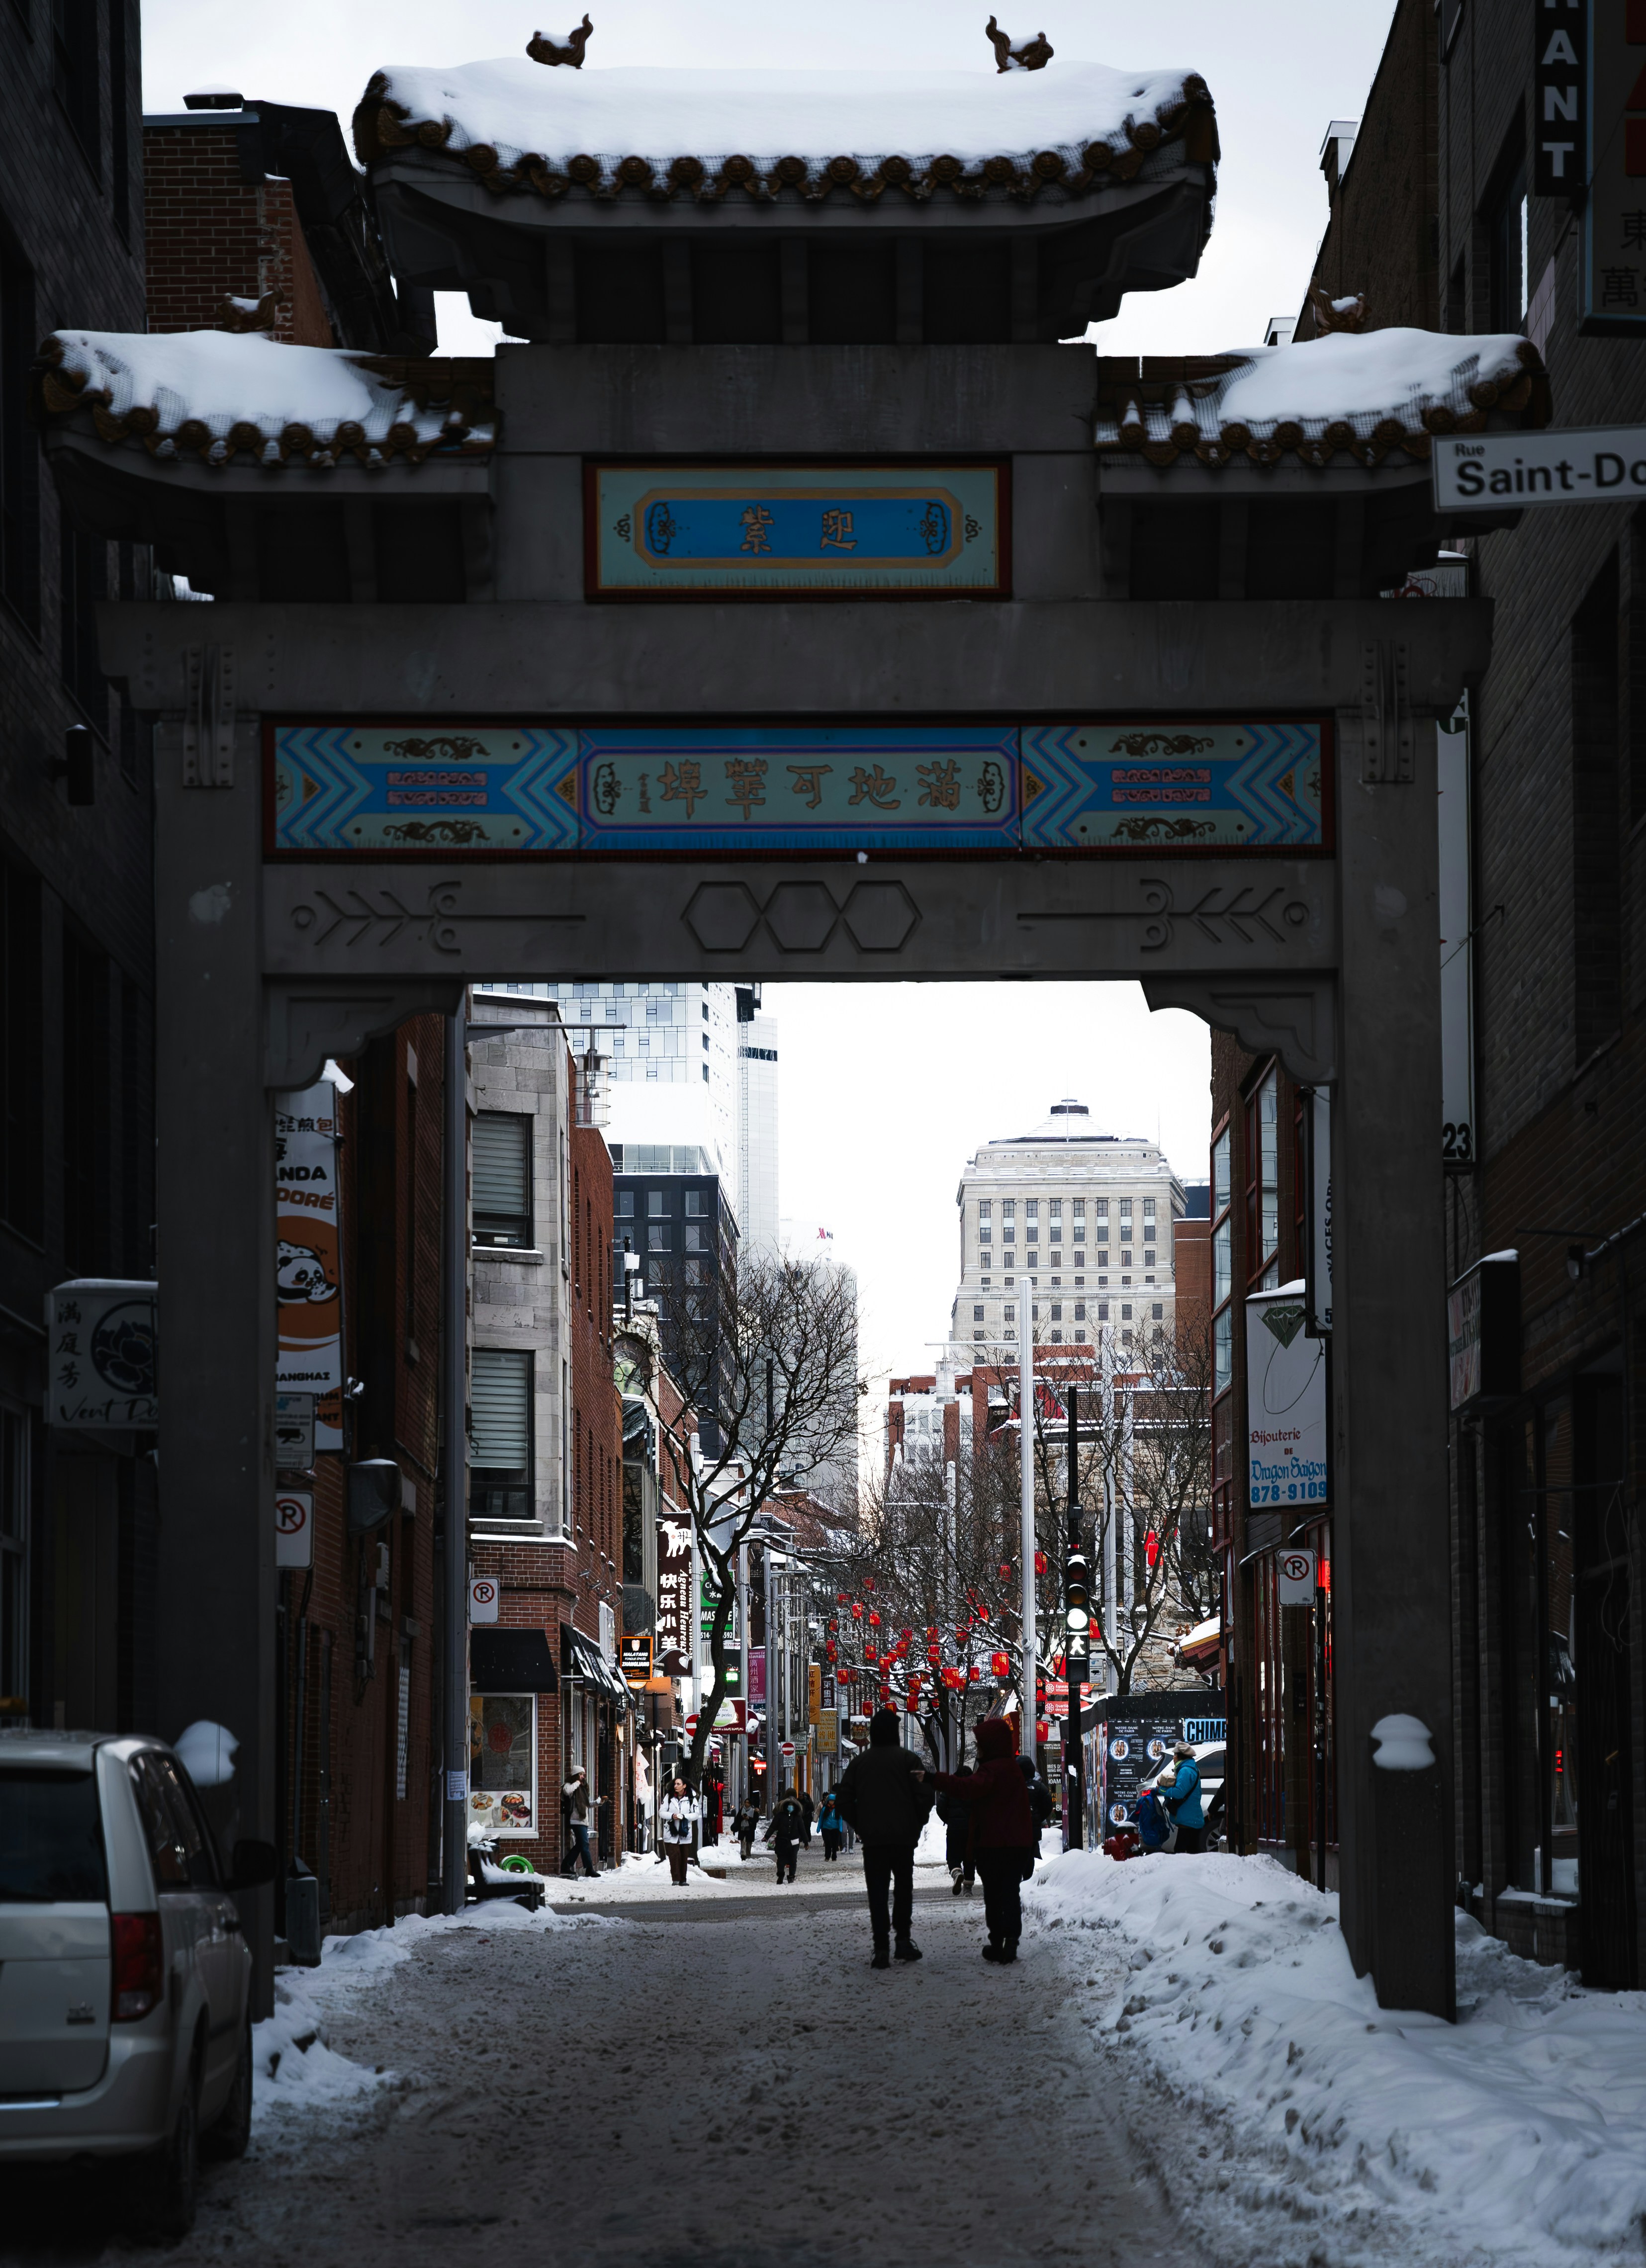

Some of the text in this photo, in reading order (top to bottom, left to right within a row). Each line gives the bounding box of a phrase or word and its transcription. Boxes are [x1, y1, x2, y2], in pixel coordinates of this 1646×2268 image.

[1541, 0, 1579, 177] ANT
[1600, 266, 1646, 308] 萬
[1456, 443, 1485, 457] Rue
[1457, 452, 1646, 496] Saint-Do
[276, 1117, 333, 1133] 生煎包
[1443, 1123, 1471, 1159] 23
[276, 1166, 327, 1181] NDA
[1250, 1427, 1301, 1447] Bijouterie
[1251, 1457, 1327, 1484] Dragon Saigon
[1251, 1481, 1327, 1503] 878-9109
[678, 1569, 689, 1607] Agneau
[701, 1611, 732, 1621] MASE
